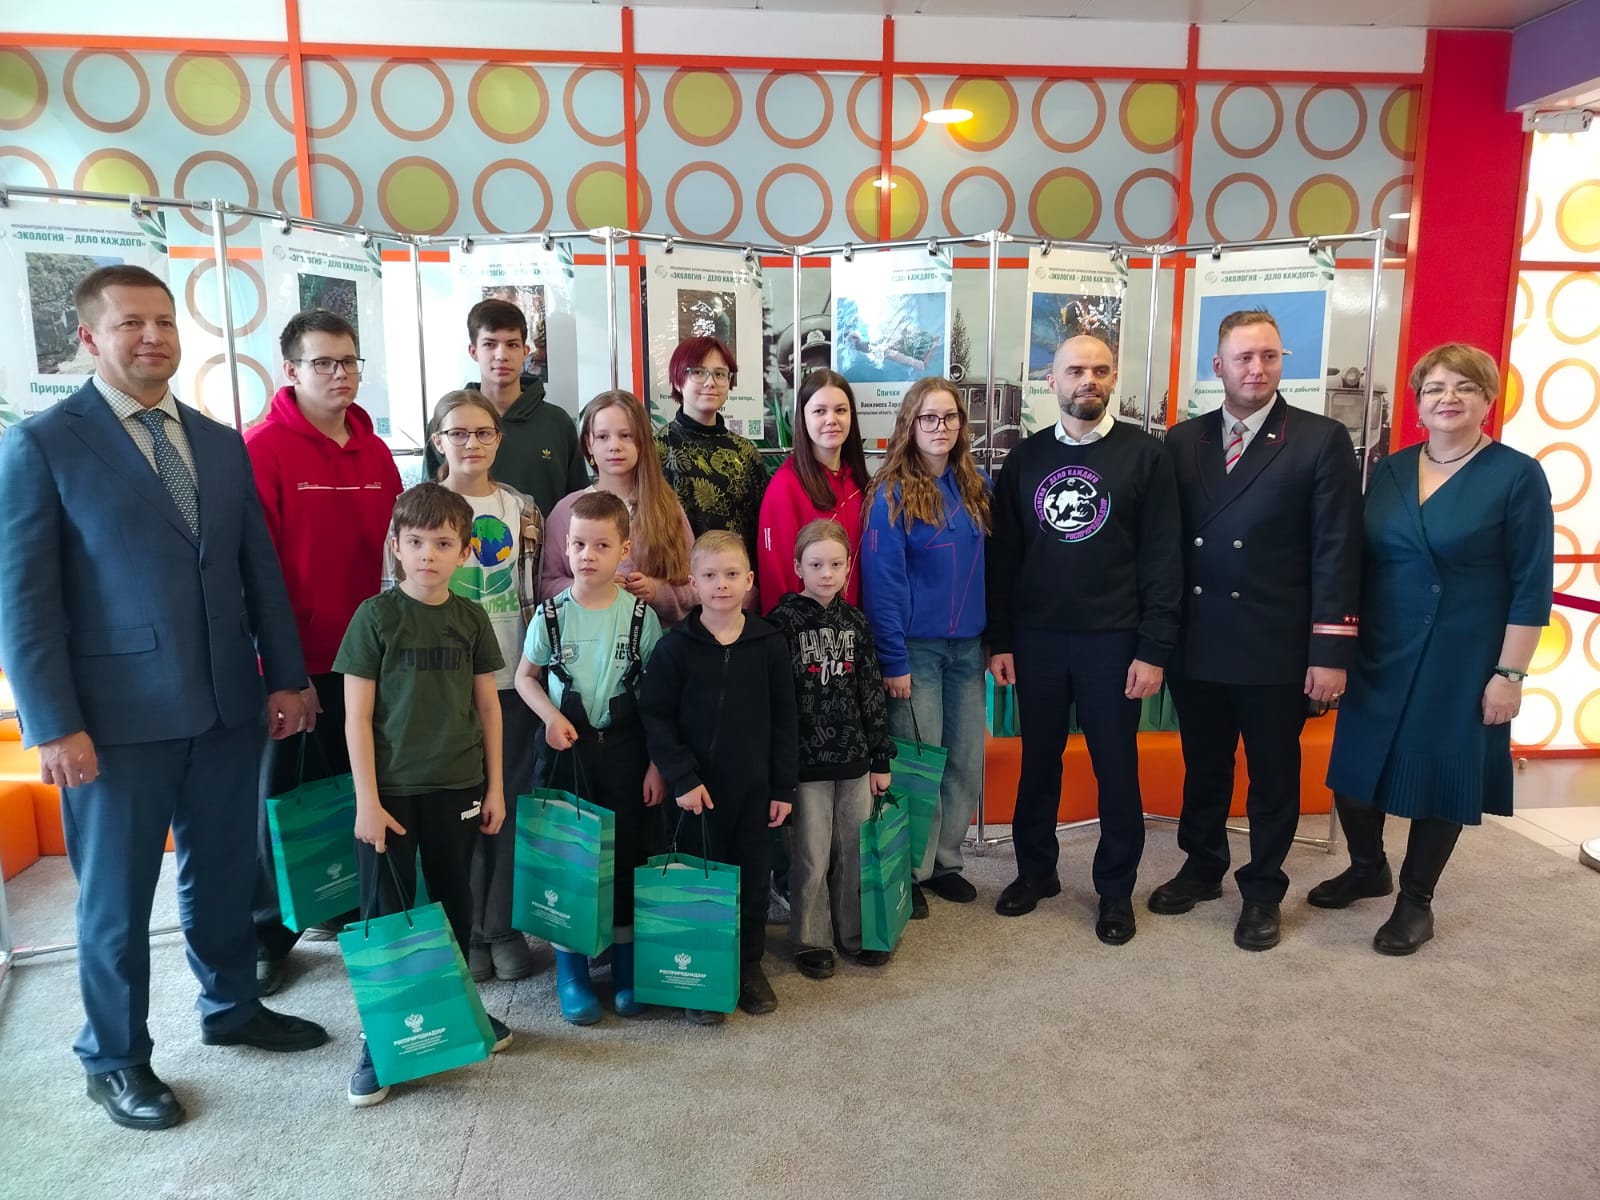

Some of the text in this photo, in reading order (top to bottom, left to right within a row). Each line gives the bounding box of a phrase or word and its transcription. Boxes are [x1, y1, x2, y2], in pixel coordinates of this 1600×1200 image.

[13, 231, 65, 242] «ЭКОЛОГИЯ
[74, 234, 98, 244] ДЕЛО
[100, 236, 147, 247] КАЖДОГО»
[1263, 273, 1282, 281] ДЕЛО
[30, 382, 80, 395] Природа
[1049, 470, 1067, 486] ДЕЛО
[1067, 469, 1099, 484] КАЖДОГО
[799, 627, 855, 665] HAVE
